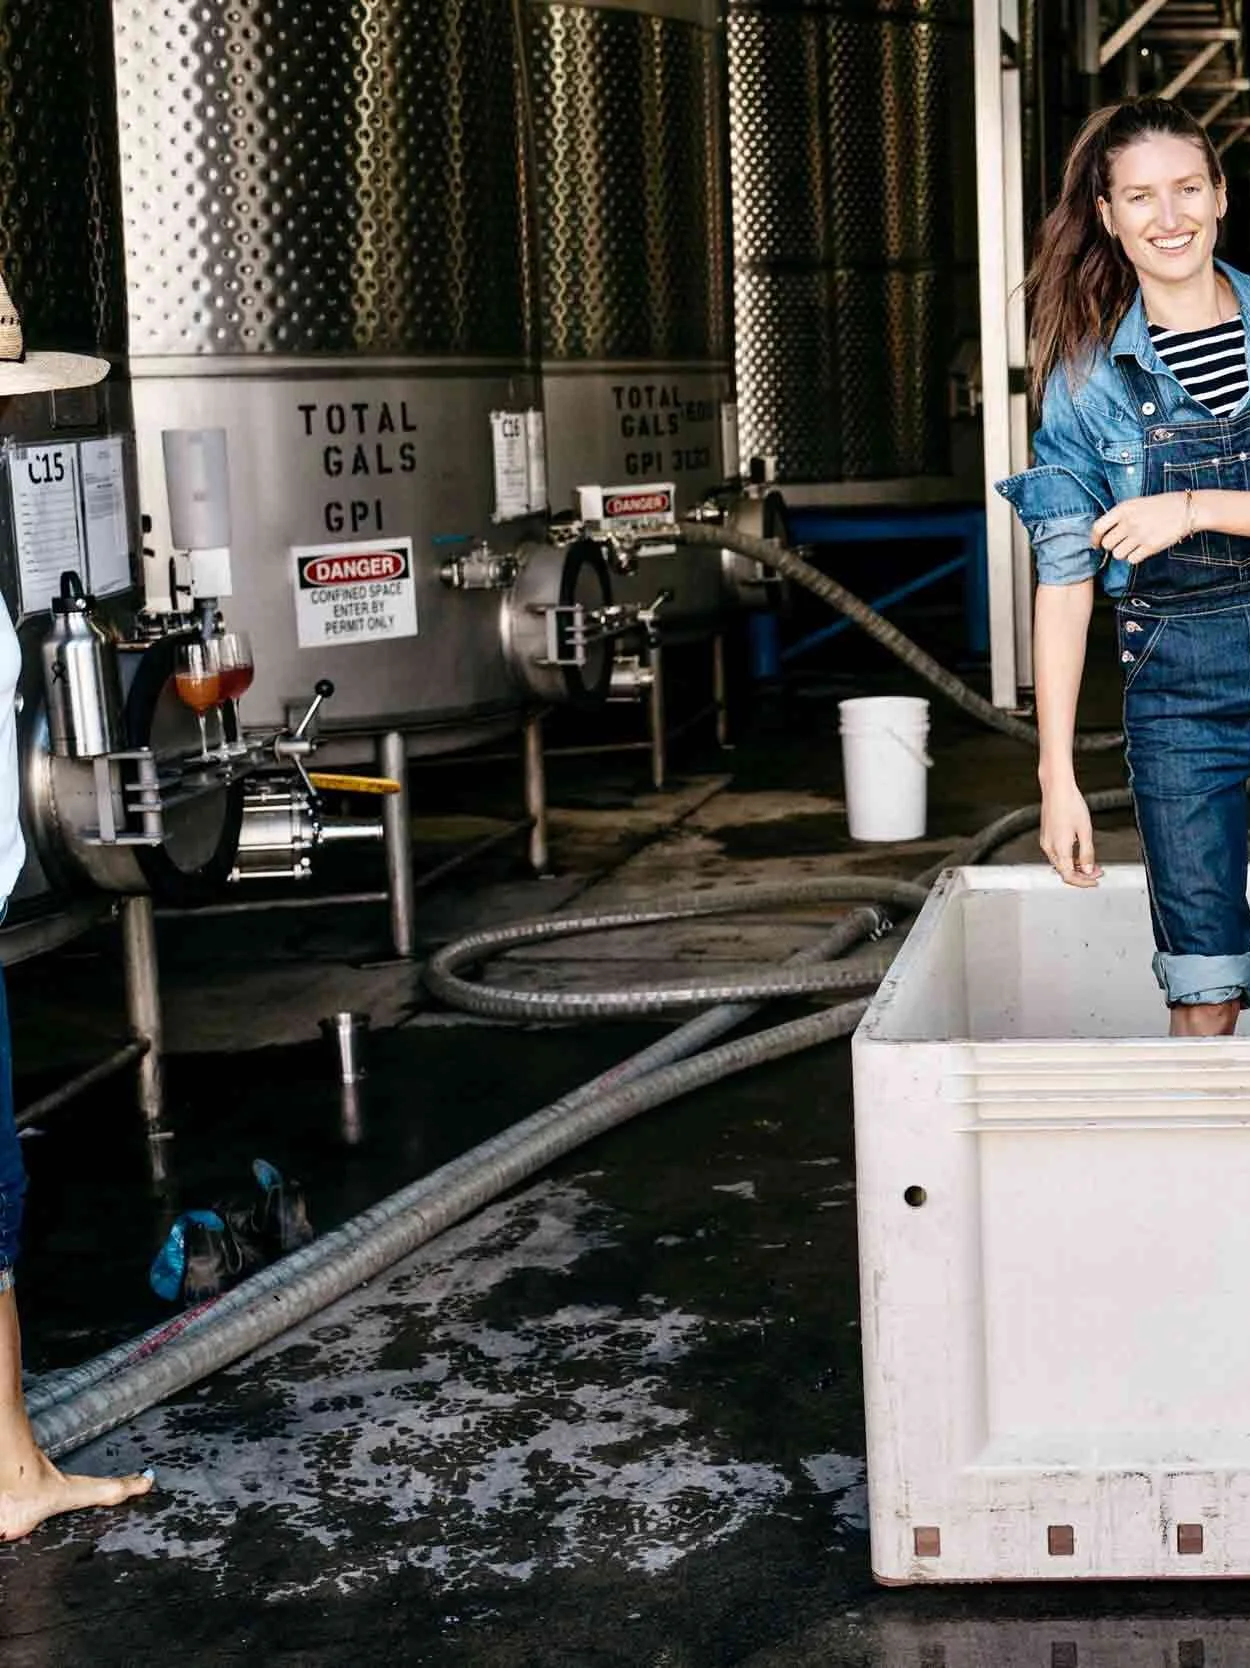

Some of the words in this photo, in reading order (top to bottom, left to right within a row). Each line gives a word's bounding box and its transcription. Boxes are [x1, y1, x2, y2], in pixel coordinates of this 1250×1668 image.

[612, 385, 681, 410] TOTAL
[297, 401, 417, 436] TOTAL
[621, 413, 679, 438] GALS
[28, 451, 65, 484] C15
[323, 442, 417, 477] GALS
[625, 450, 663, 475] GPI
[324, 498, 384, 533] GPI
[613, 495, 662, 513] DANGER
[315, 556, 395, 581] DANGER
[310, 585, 368, 605] CONFINED
[368, 581, 403, 598] SPACE
[333, 602, 369, 618] ENTER
[371, 600, 385, 614] BY
[324, 618, 365, 635] PERMIT
[367, 615, 395, 631] ONLY
